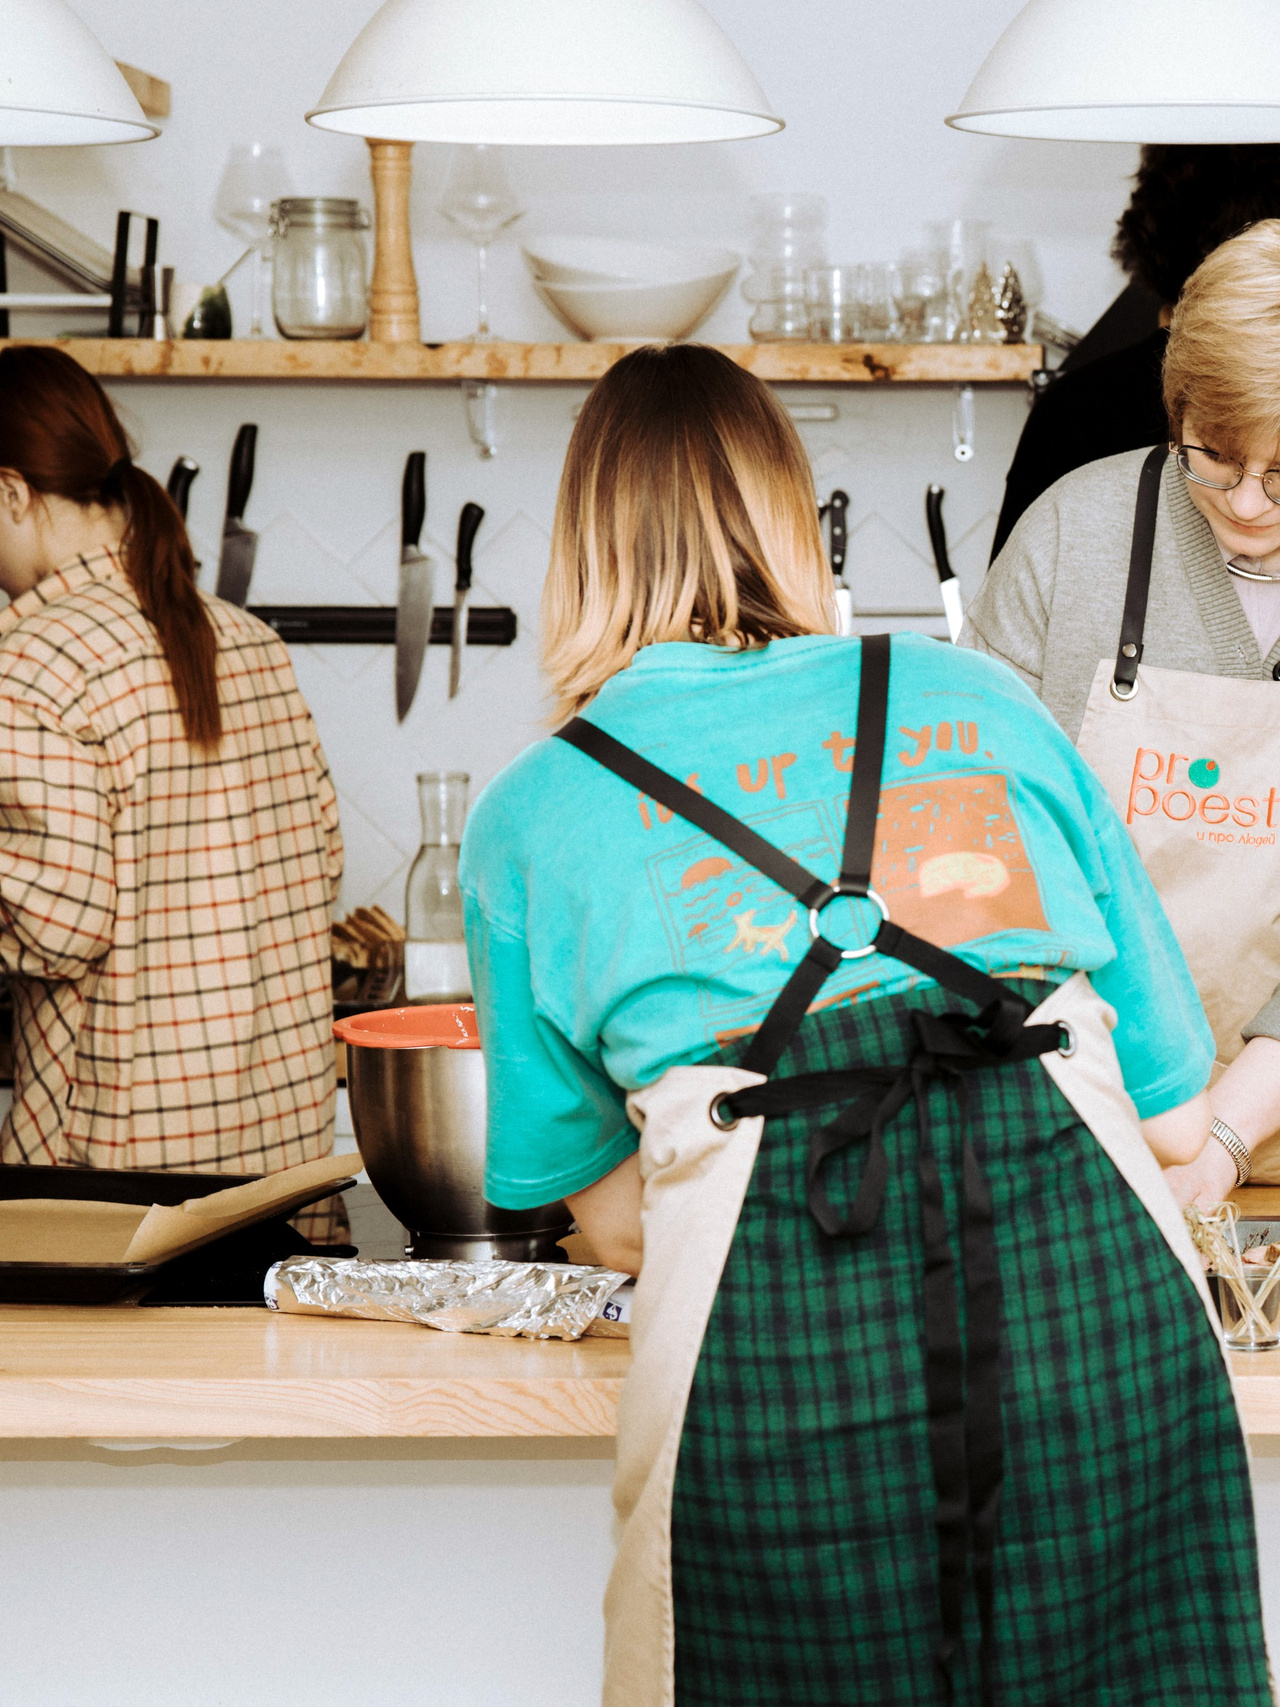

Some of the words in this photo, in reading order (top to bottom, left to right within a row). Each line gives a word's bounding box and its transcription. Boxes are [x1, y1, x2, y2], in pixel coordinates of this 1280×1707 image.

[736, 752, 797, 800] up
[822, 731, 857, 773] t
[1126, 782, 1280, 828] poest
[1208, 832, 1235, 844] про
